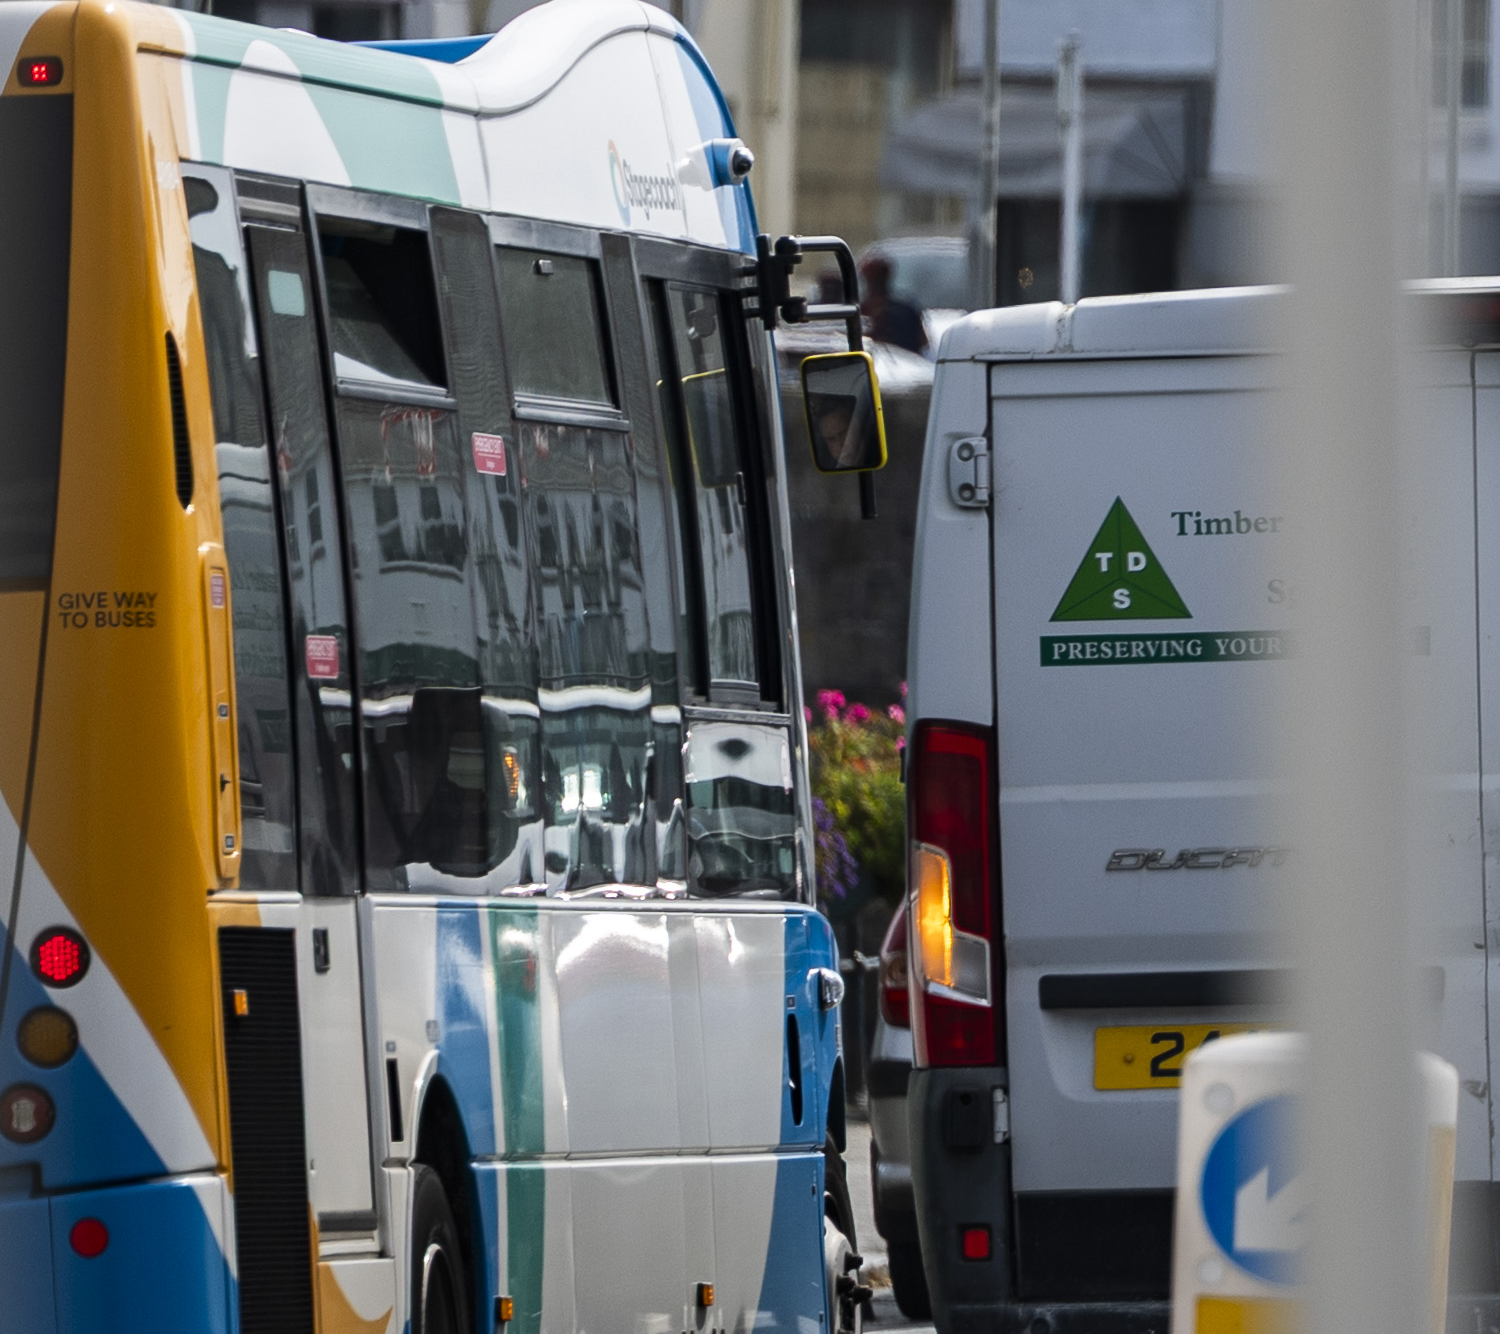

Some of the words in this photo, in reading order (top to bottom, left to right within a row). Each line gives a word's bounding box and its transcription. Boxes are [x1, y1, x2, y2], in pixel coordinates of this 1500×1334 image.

[1170, 510, 1284, 537] Timber
[1095, 551, 1114, 572] T
[1127, 550, 1148, 572] D
[58, 591, 108, 610] GIVE
[115, 591, 158, 609] WAY
[1112, 588, 1132, 609] S
[59, 611, 88, 629] TO
[94, 610, 158, 628] BUSES
[1052, 639, 1203, 660] PRESERVING
[1215, 636, 1282, 657] YOUR
[1105, 845, 1292, 873] DUCAT
